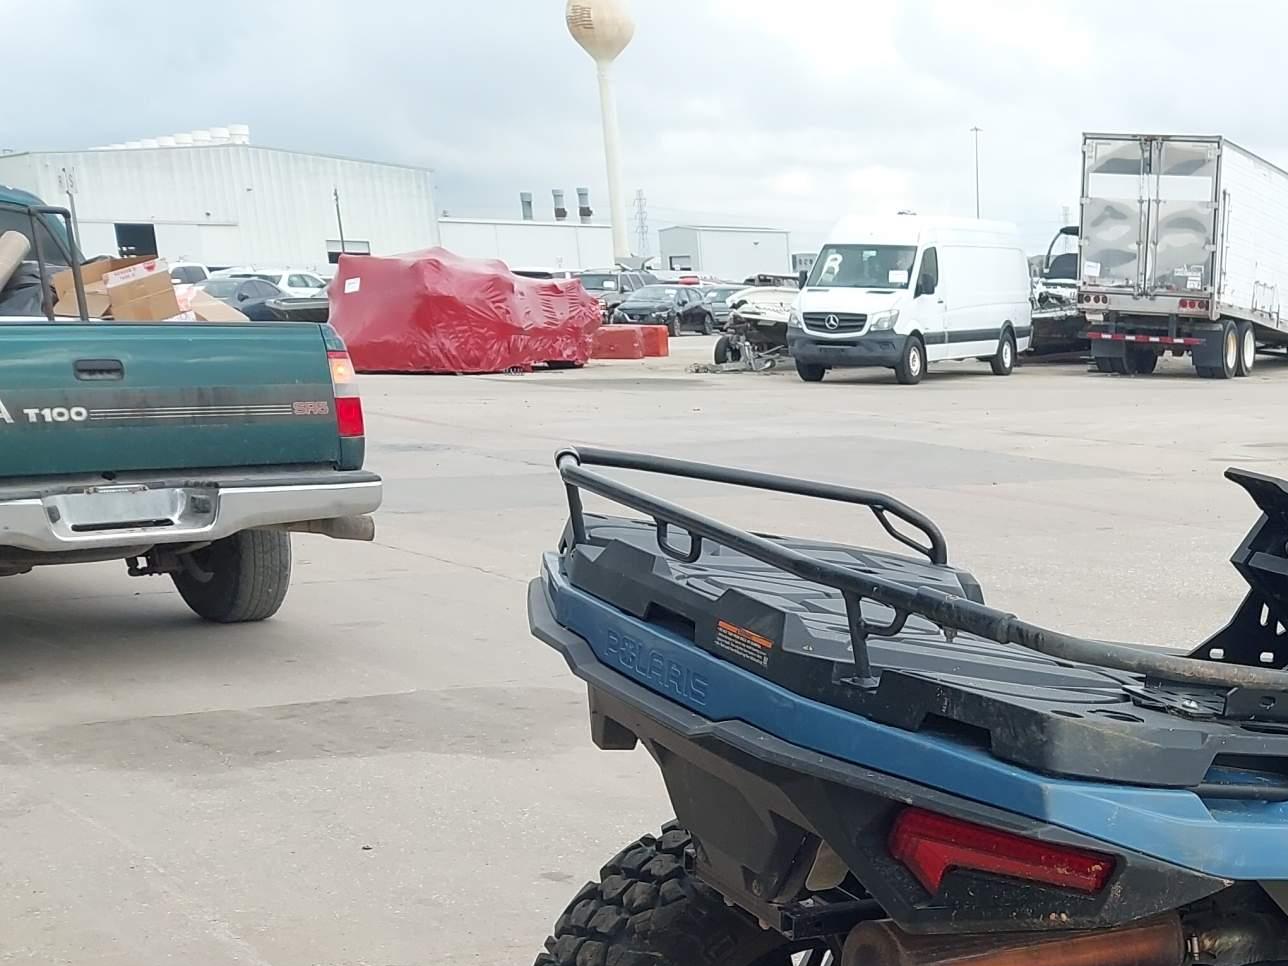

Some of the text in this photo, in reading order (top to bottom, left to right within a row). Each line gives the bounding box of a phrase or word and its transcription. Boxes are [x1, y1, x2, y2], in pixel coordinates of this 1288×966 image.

[23, 406, 88, 423] T100
[292, 401, 329, 415] SR5
[603, 627, 709, 706] POLARIS
